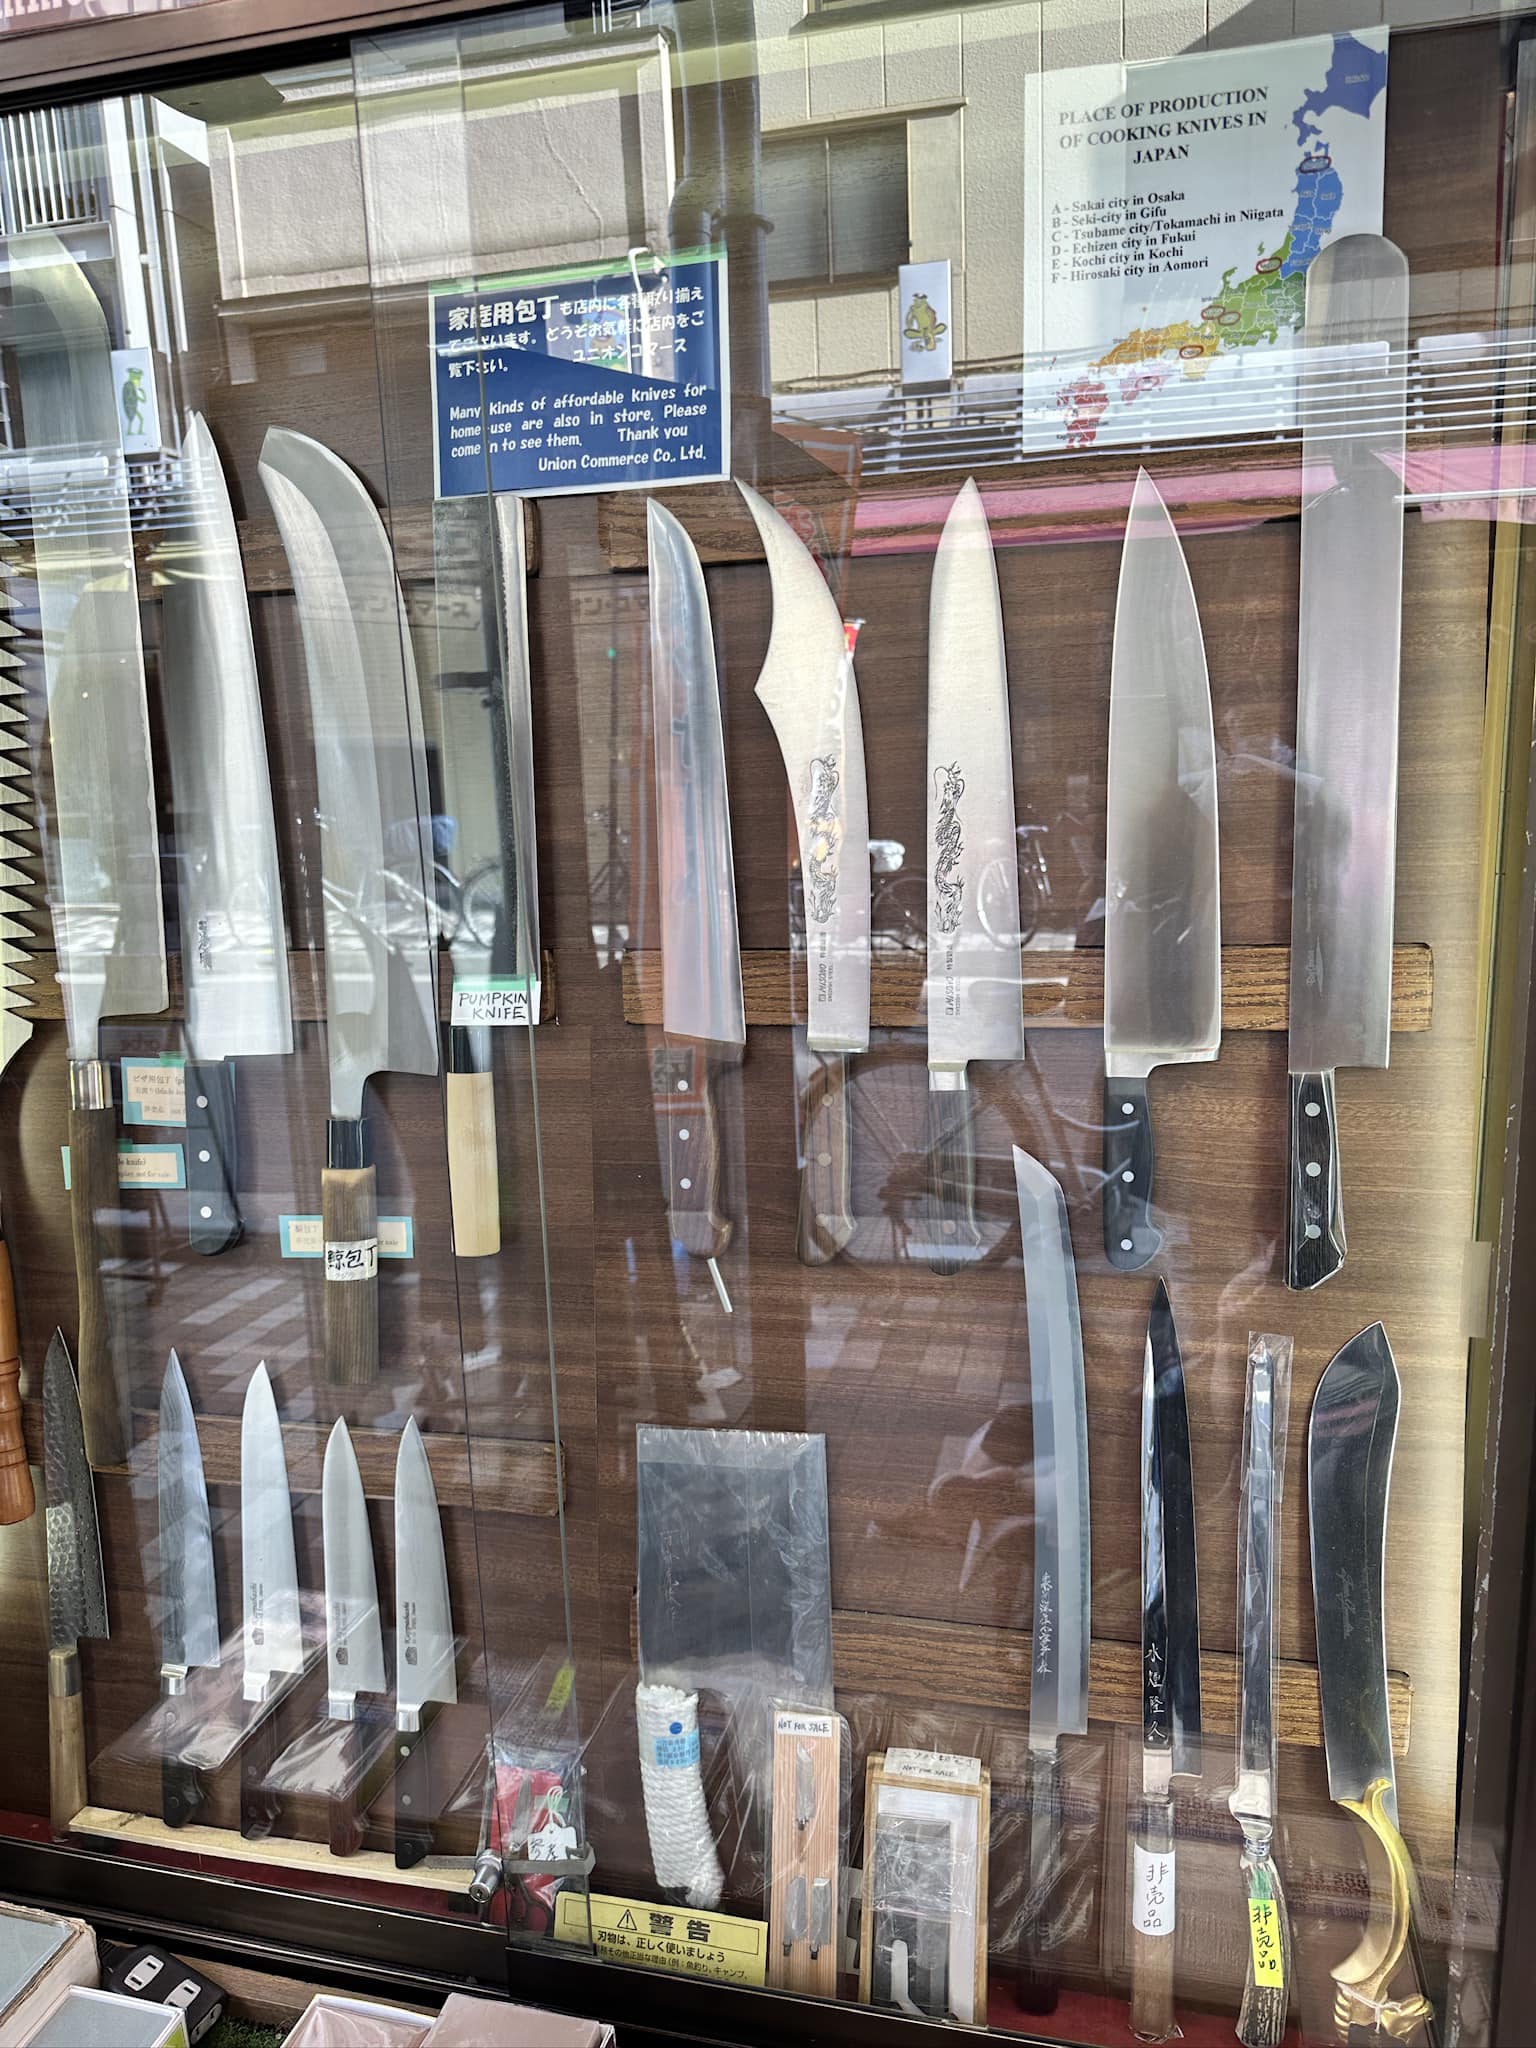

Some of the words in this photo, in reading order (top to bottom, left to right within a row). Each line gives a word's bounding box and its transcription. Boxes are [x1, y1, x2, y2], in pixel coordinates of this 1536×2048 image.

[1059, 106, 1116, 126] PLACE
[1121, 103, 1144, 119] OF
[1150, 87, 1268, 115] PRODUCTION
[1060, 134, 1083, 149] OF
[1087, 123, 1171, 146] COOKING
[1177, 114, 1243, 135] KNIVES
[1248, 111, 1267, 126] IN
[1133, 144, 1189, 164] JAPAN
[1052, 204, 1061, 214] A
[1072, 199, 1105, 212] Sakai
[1108, 198, 1130, 209] city
[1133, 195, 1144, 205] in
[1148, 191, 1185, 204] Osaka
[1051, 231, 1061, 242] C
[1072, 226, 1126, 240] Tsubame
[1224, 212, 1236, 223] in
[1240, 208, 1284, 221] Niigata
[1052, 218, 1061, 228] B
[1071, 211, 1122, 227] Seki-city
[1125, 210, 1137, 220] in
[1140, 206, 1167, 219] Gifu
[1052, 245, 1061, 256] D
[1073, 241, 1117, 254] Echizen
[1121, 237, 1142, 249] city
[1146, 235, 1157, 246] in
[1161, 231, 1196, 245] Fukui
[1052, 260, 1060, 270] E
[1072, 254, 1106, 268] Kochi
[1109, 252, 1130, 264] city
[1133, 251, 1144, 261] in
[1149, 246, 1183, 259] Kochi
[1052, 273, 1060, 283] F
[1071, 267, 1121, 281] Hirosaki
[1124, 265, 1145, 277] city
[1148, 263, 1159, 273] in
[1163, 257, 1208, 272] Aomori
[450, 405, 481, 420] Many
[531, 396, 546, 411] of
[553, 391, 624, 409] affordable
[684, 383, 707, 397] for
[522, 418, 543, 431] are
[553, 413, 580, 428] also
[590, 410, 603, 425] in
[664, 404, 707, 420] Please
[451, 444, 481, 458] come
[502, 437, 516, 451] to
[520, 437, 542, 449] see
[547, 433, 582, 448] them.
[617, 426, 659, 442] Thank
[664, 425, 688, 440] you
[538, 456, 576, 472] Union
[580, 450, 648, 469] Commerce
[459, 992, 527, 1007] PUMPKIN
[473, 1006, 526, 1020] KNIFE
[778, 1717, 792, 1729] NOT
[794, 1721, 807, 1731] FOR
[808, 1722, 829, 1733] SALE
[1143, 1861, 1169, 1928] 非売品
[649, 1912, 711, 1943] 警告
[1252, 1904, 1277, 1970] 非売品
[597, 1930, 725, 1963] 刃物は、正しく使いましょう
